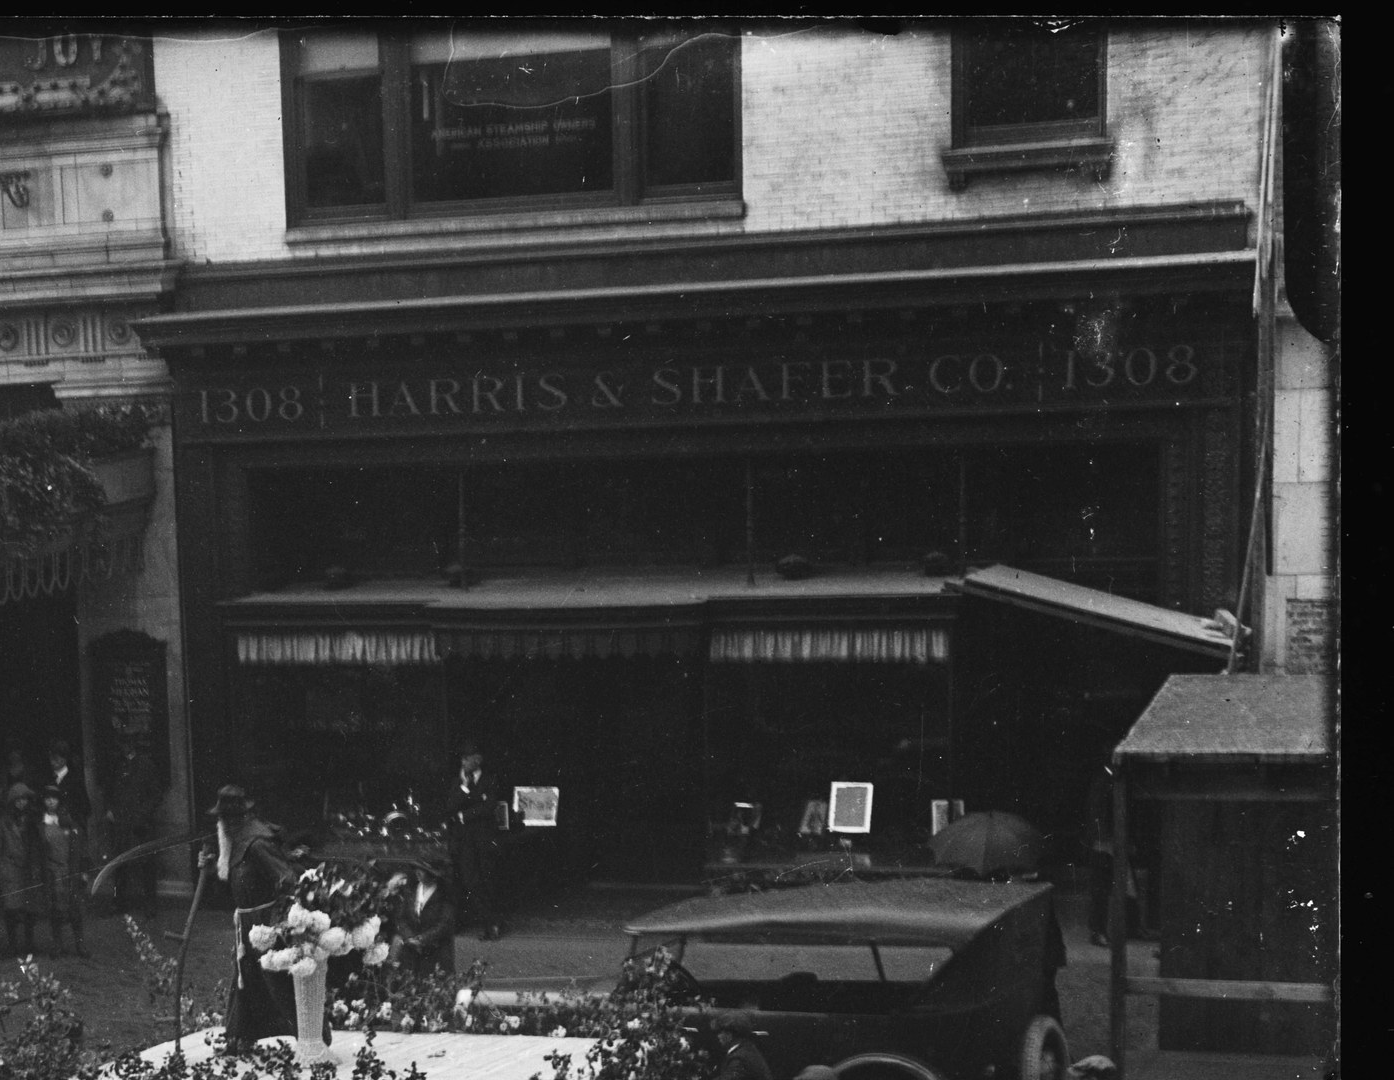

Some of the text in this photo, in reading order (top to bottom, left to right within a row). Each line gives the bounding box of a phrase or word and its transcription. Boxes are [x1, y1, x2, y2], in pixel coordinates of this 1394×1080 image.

[23, 34, 104, 71] JOY
[477, 134, 549, 149] ASSOCIATION
[486, 121, 548, 136] STEAMSHIP
[1062, 344, 1199, 390] 1308
[198, 384, 304, 424] 1308
[346, 374, 568, 419] HARRIS
[591, 371, 625, 408] &
[651, 358, 901, 405] SHAFER
